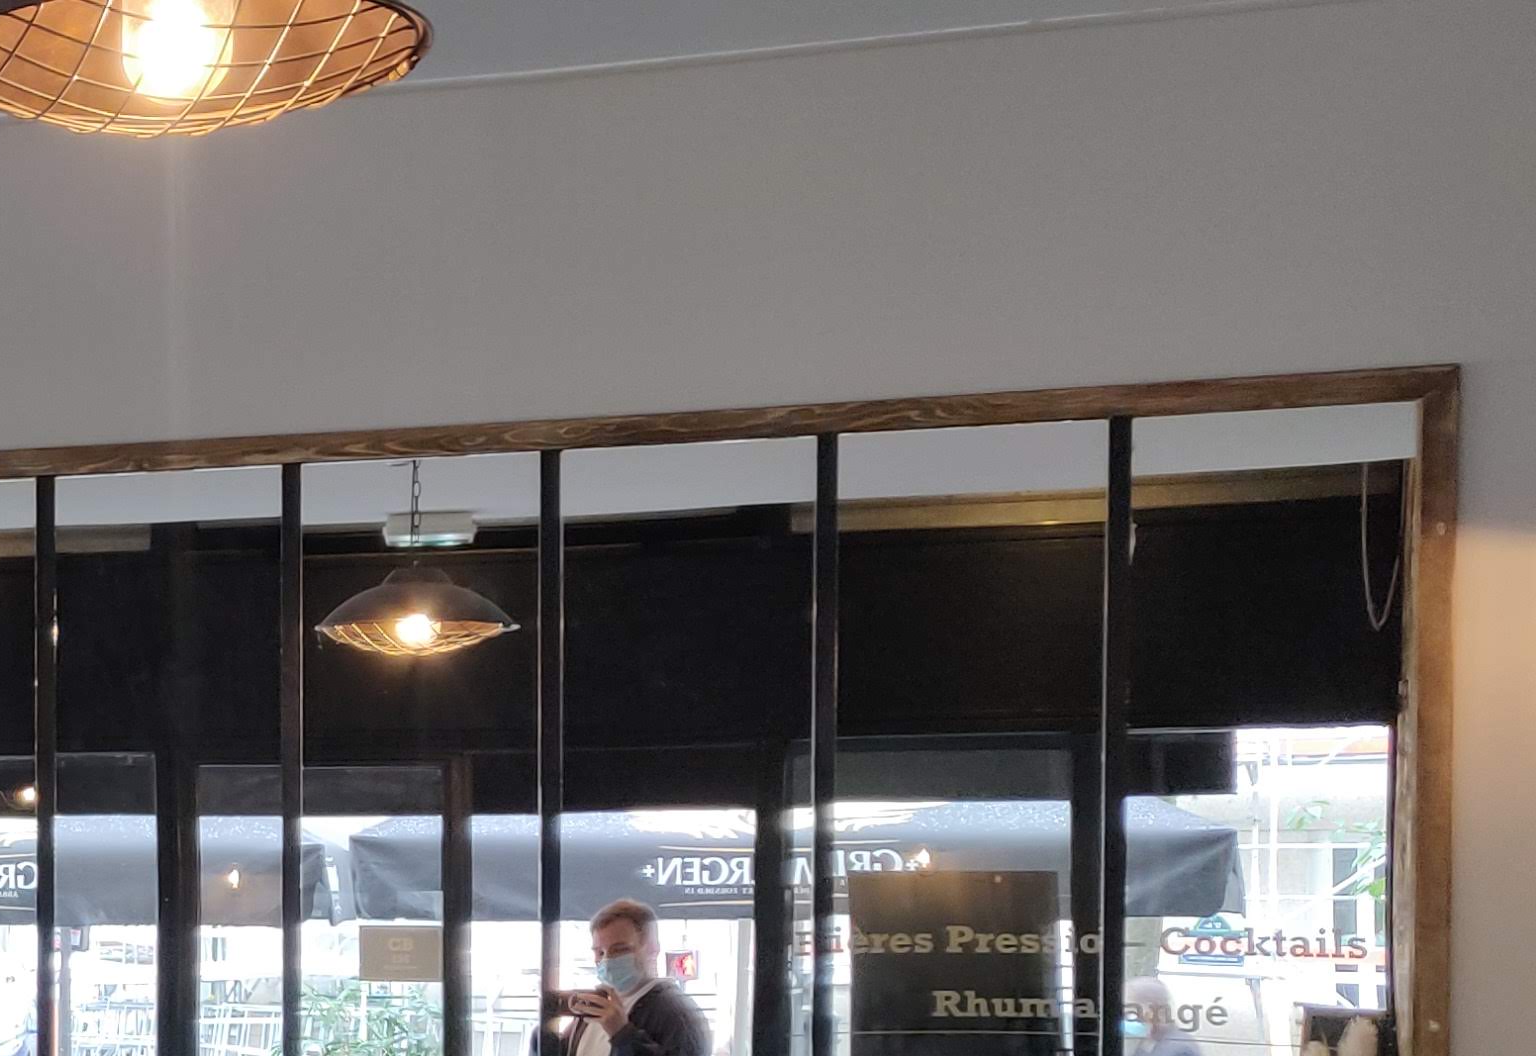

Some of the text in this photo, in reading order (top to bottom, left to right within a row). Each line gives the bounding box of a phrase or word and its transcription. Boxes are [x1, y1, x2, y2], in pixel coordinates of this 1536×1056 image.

[946, 924, 1103, 954] Pressio
[1159, 926, 1368, 960] Cocktails
[1074, 996, 1228, 1033] aangé
